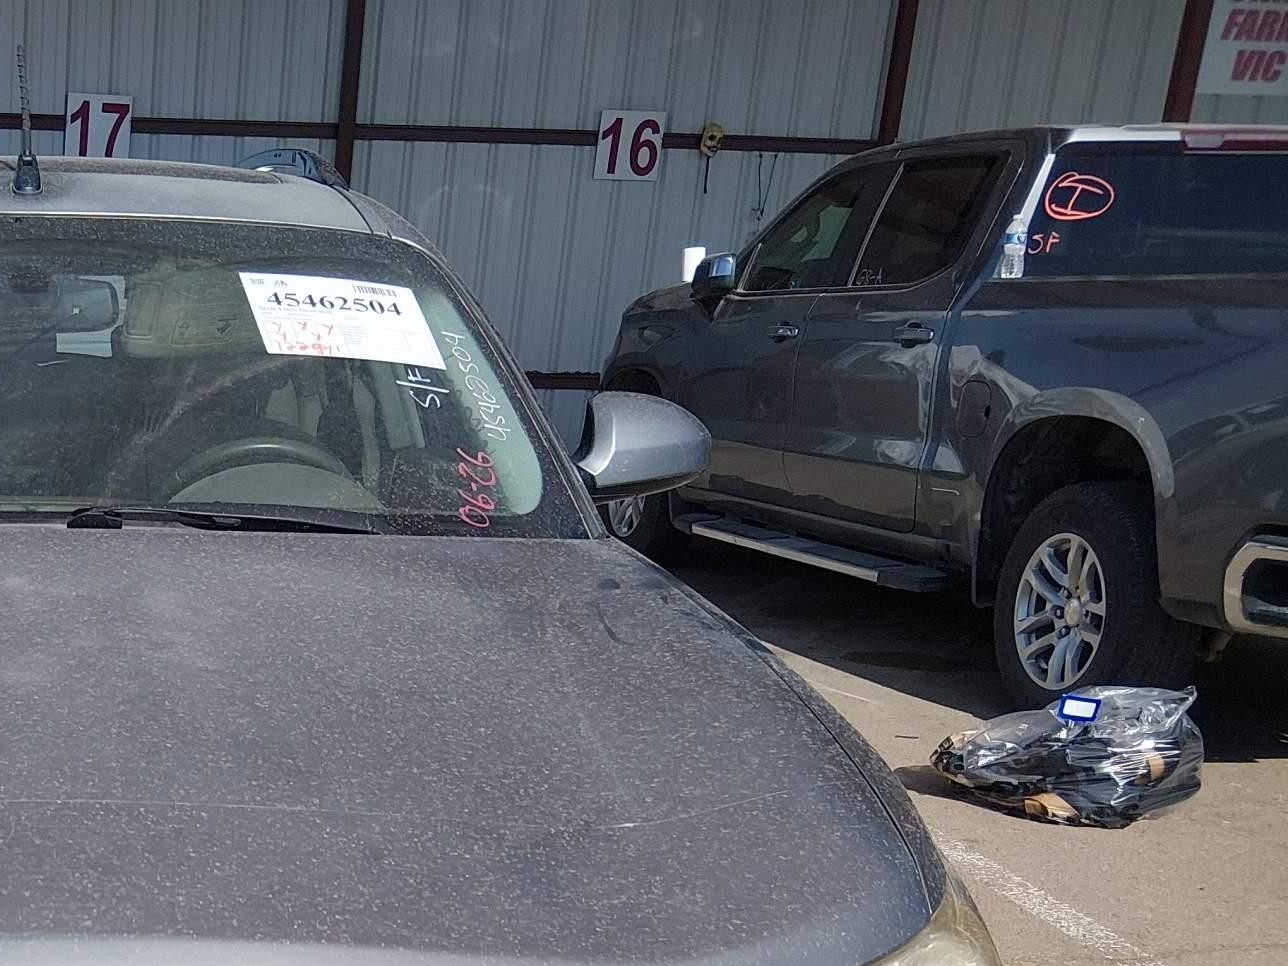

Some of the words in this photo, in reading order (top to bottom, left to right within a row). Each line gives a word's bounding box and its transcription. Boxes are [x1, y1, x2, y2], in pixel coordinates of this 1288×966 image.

[70, 100, 130, 157] 17
[601, 117, 660, 176] 16
[267, 291, 402, 316] 45462504
[395, 367, 450, 409] S/F
